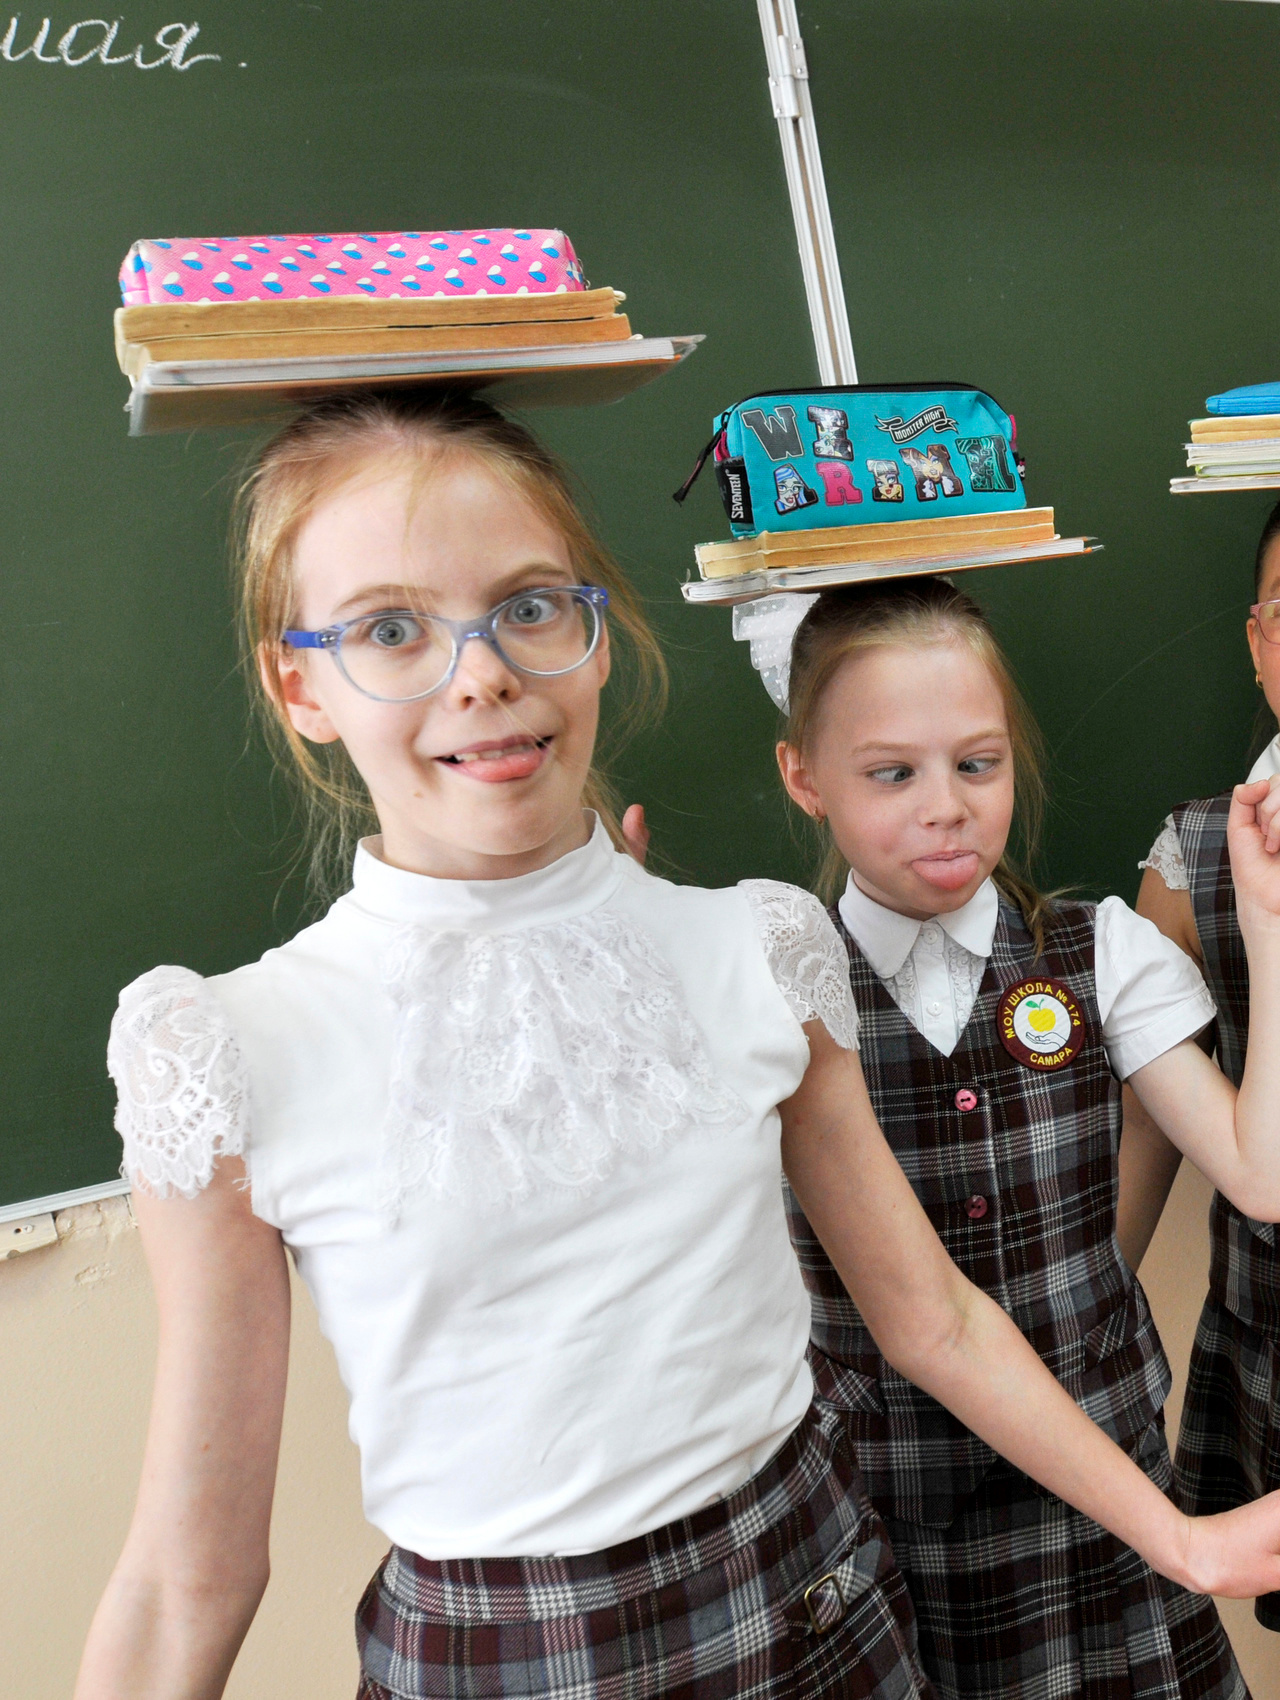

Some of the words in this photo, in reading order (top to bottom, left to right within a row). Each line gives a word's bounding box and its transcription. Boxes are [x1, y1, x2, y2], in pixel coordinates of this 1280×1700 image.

[894, 418, 925, 440] MONSTER
[728, 473, 744, 519] SEVENTEEN
[1008, 982, 1053, 1006] ШКОЛА
[1055, 989, 1068, 1003] №
[1003, 1006, 1016, 1039] МОУ
[1068, 1004, 1081, 1026] 174
[1030, 1046, 1073, 1066] САМАРА
